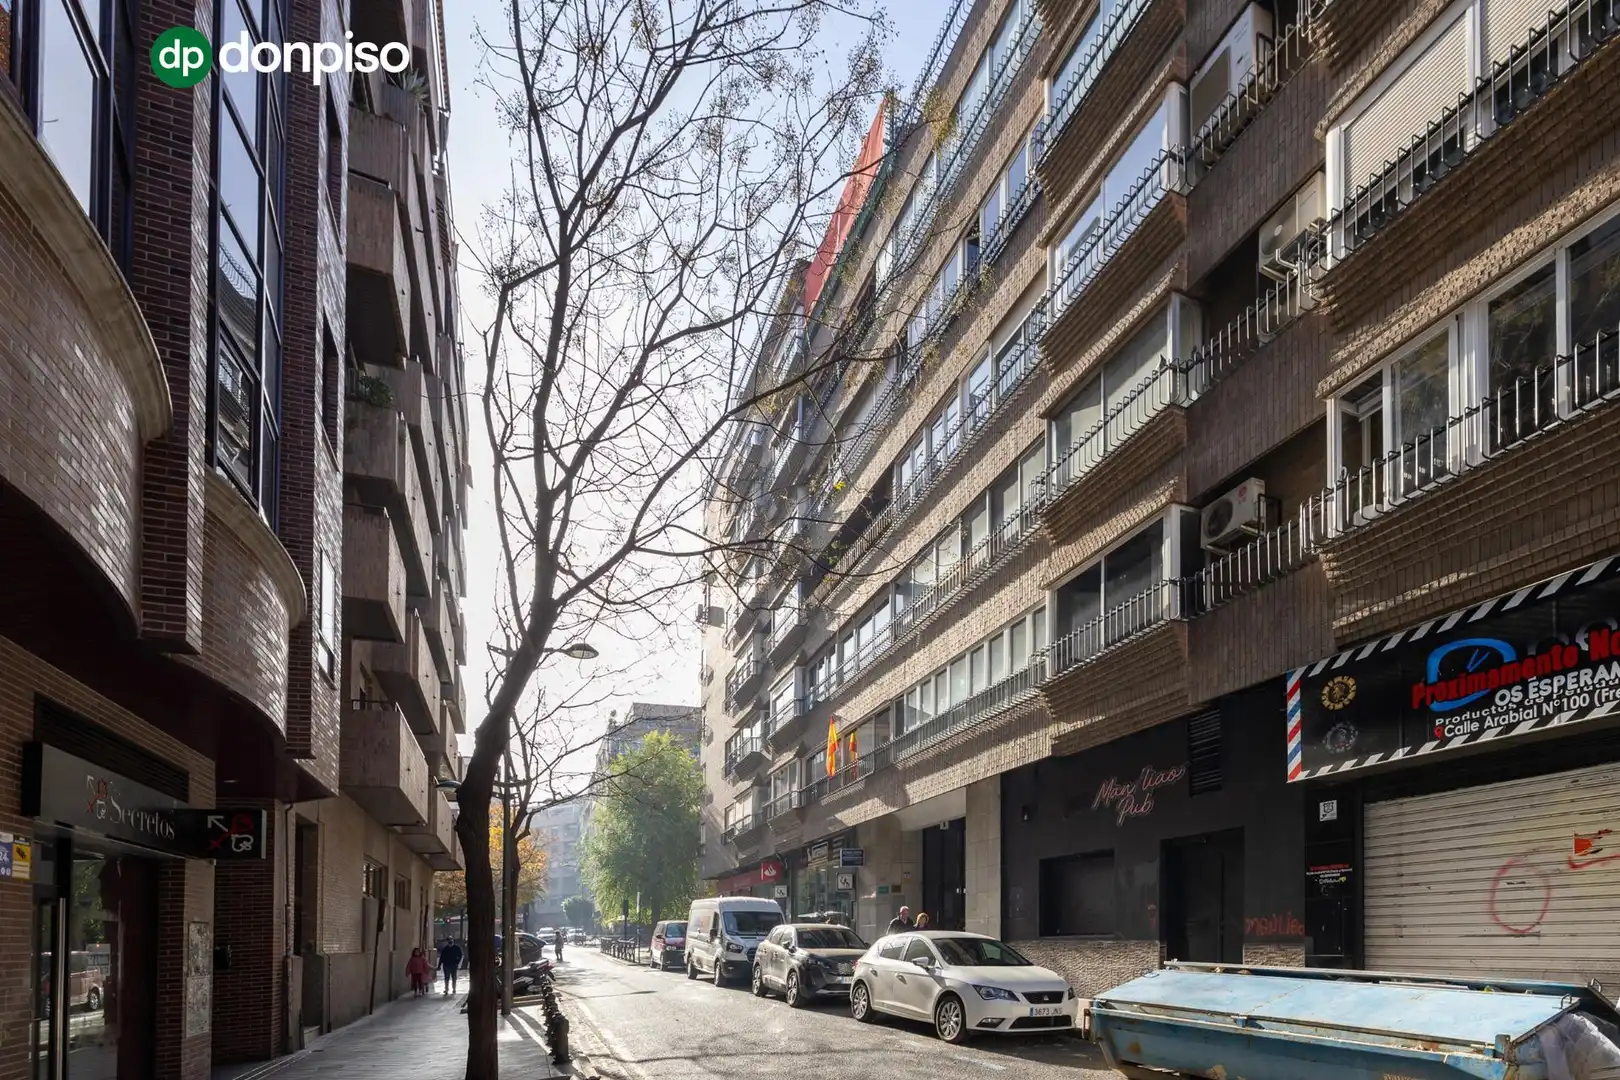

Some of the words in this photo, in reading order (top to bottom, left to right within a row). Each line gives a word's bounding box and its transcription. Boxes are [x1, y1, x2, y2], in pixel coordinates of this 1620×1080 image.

[1495, 685, 1523, 706] OS
[1444, 720, 1480, 737] Calle
[1484, 705, 1537, 729] Arabial
[110, 796, 175, 840] Secretos
